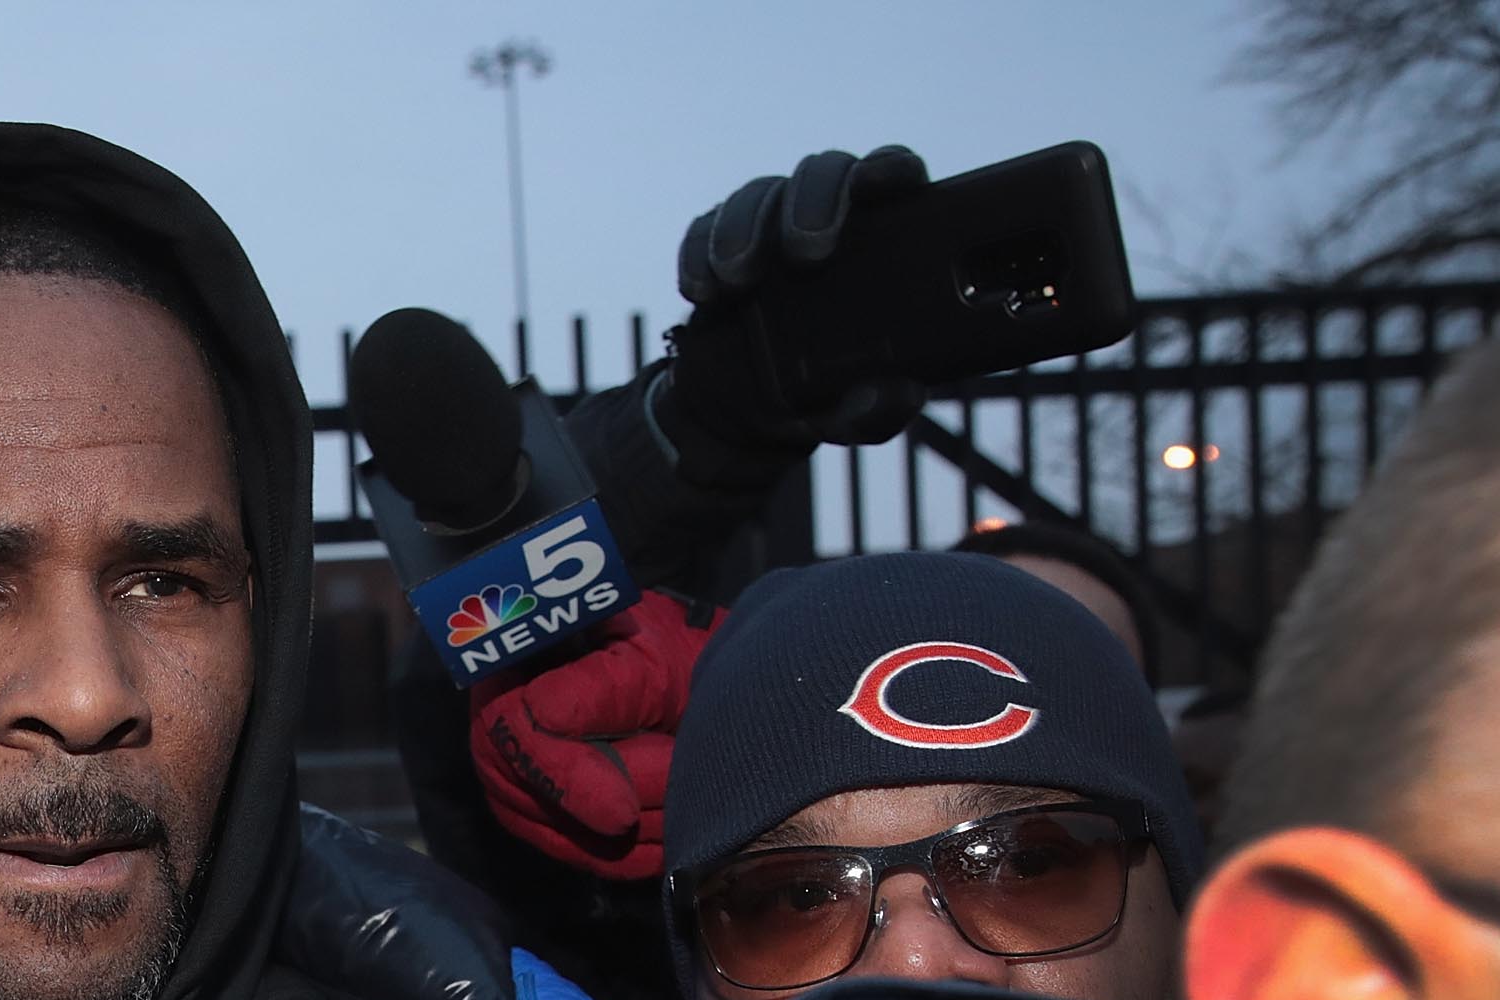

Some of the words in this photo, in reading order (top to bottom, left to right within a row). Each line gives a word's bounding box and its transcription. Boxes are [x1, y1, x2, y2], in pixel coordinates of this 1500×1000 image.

[522, 515, 606, 599] 5
[460, 581, 619, 675] NEWS
[837, 641, 1040, 749] C
